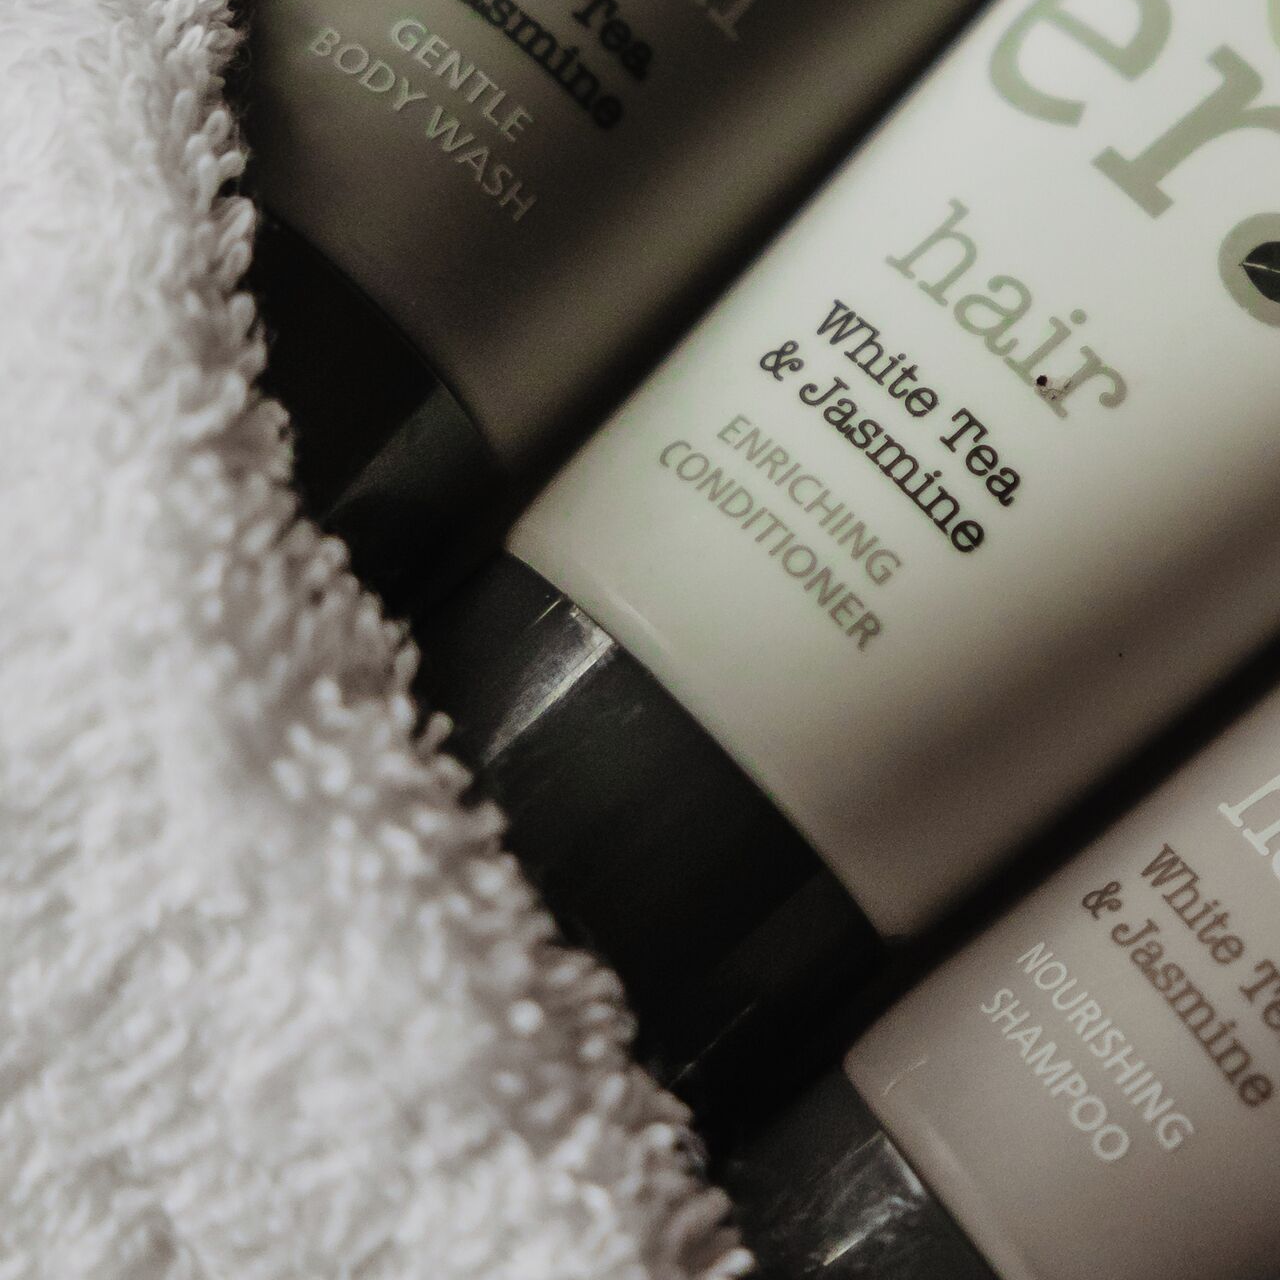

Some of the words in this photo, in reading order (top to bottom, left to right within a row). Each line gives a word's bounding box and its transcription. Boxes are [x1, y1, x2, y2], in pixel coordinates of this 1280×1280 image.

[308, 27, 427, 113] BODY
[424, 105, 538, 222] WASH
[390, 17, 534, 142] GENTLE
[815, 298, 940, 418] White
[939, 407, 1022, 508] Tea
[884, 196, 1129, 420] hair
[658, 439, 885, 652] CONDITIONER
[715, 414, 904, 586] ENRICHING
[759, 339, 805, 382] &
[798, 375, 987, 554] Jasmine
[1081, 880, 1123, 920] &
[1110, 918, 1275, 1109] Jasmine
[1139, 842, 1245, 966] White
[979, 987, 1131, 1163] SHAMPOO
[1016, 941, 1195, 1151] NOURISHING
